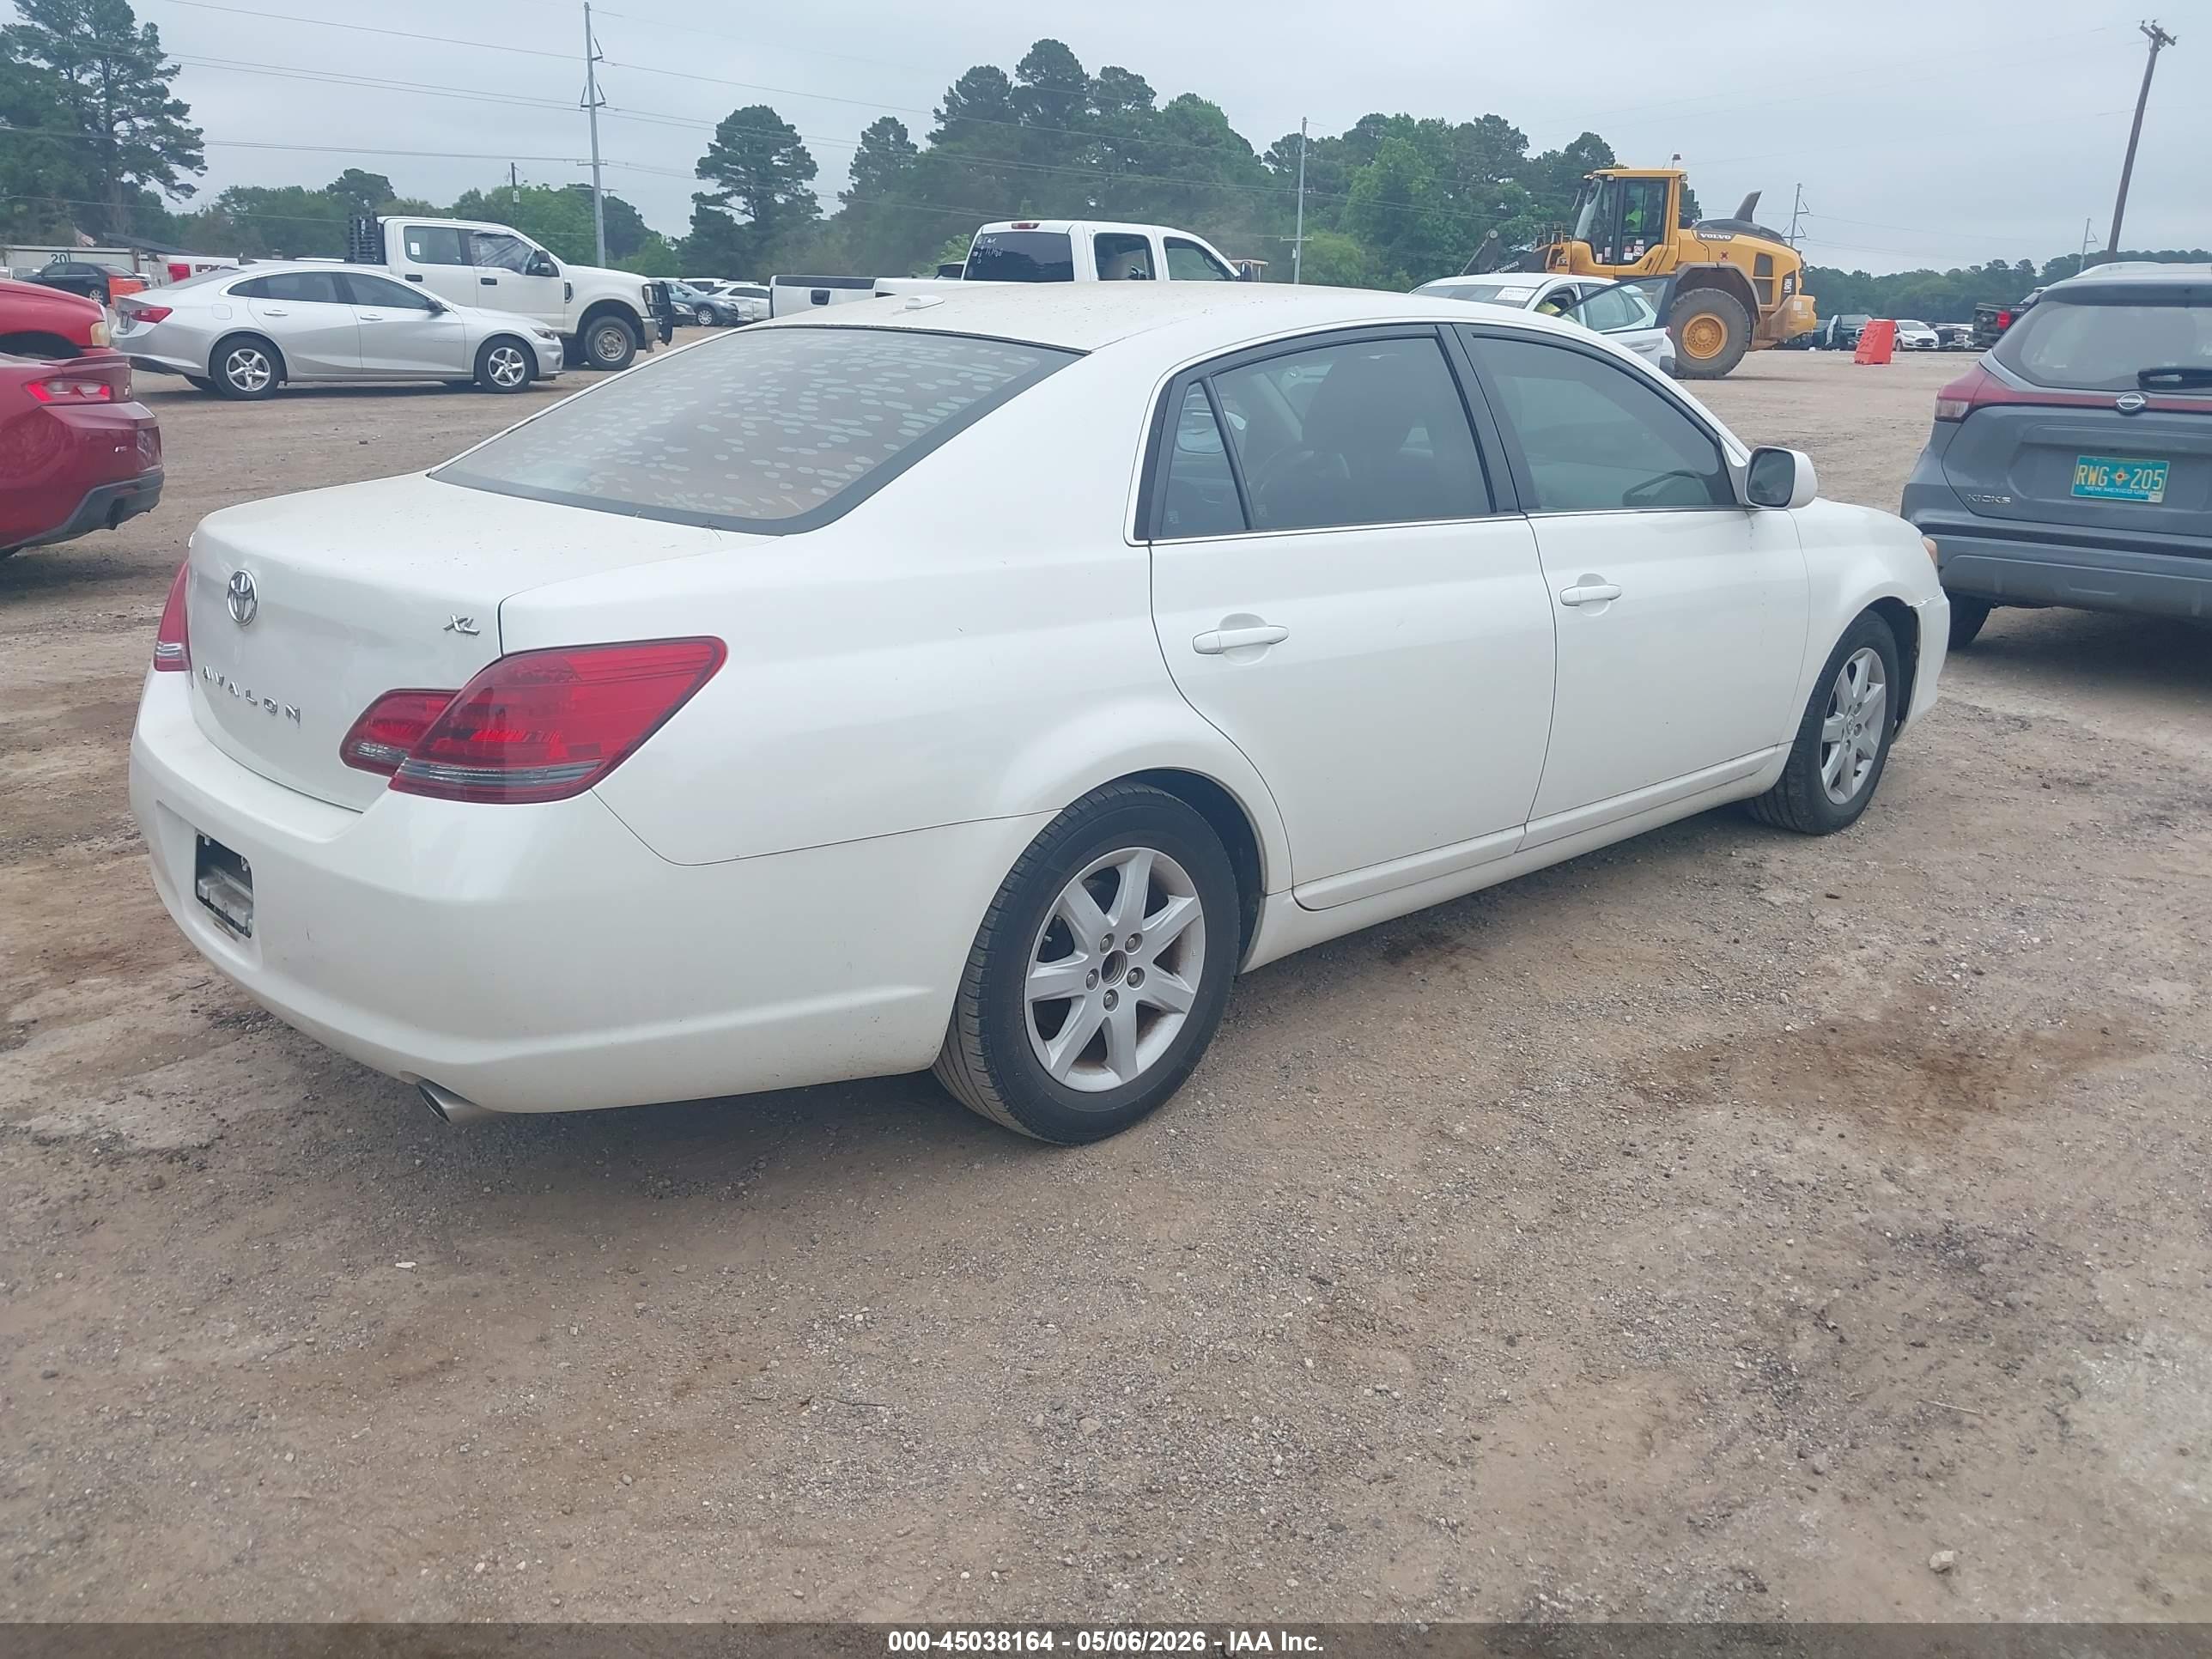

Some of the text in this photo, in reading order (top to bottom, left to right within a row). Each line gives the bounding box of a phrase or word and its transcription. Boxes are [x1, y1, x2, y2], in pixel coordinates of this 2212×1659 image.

[2075, 465, 2165, 490] RWG 205
[442, 614, 481, 636] XL
[203, 665, 301, 723] AVALON
